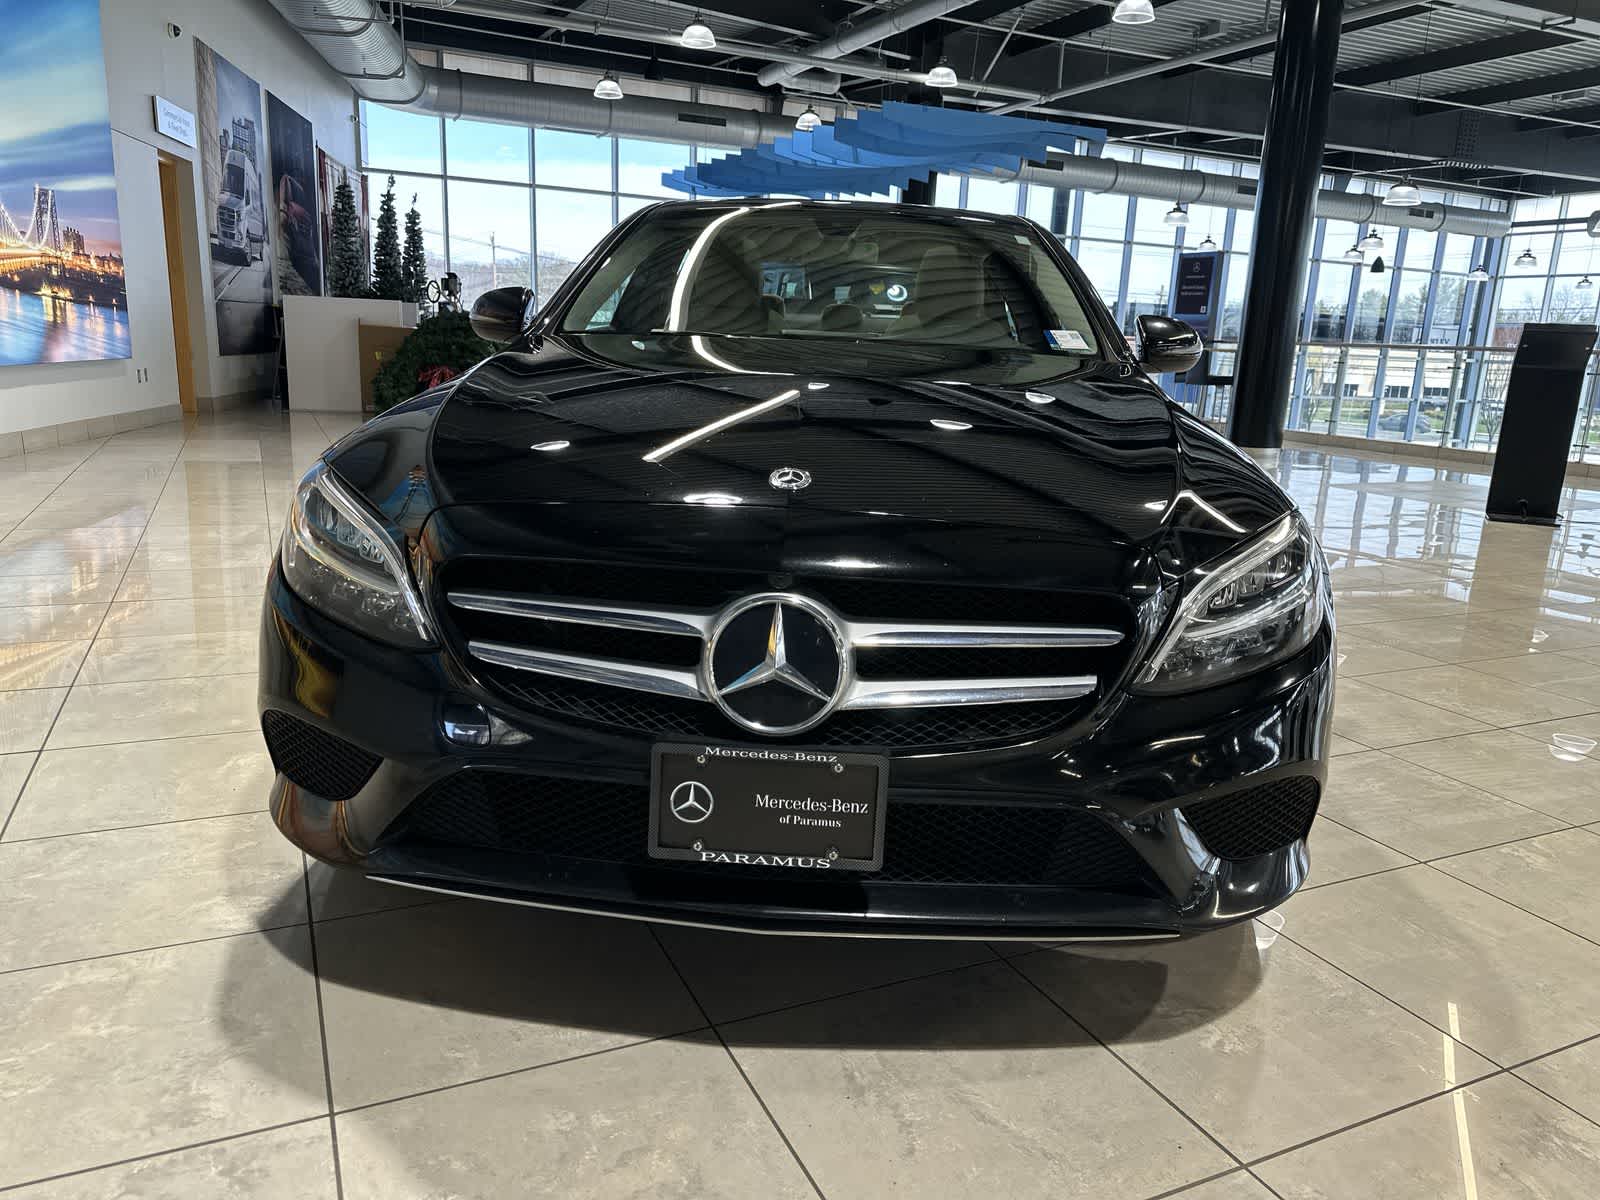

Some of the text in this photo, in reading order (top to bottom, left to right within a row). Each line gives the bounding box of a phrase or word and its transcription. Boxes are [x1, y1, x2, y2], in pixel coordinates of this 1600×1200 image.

[704, 746, 838, 763] Mercedes-Benz
[754, 793, 869, 814] Mercedes-Benz
[779, 814, 842, 828] of Paramus
[700, 851, 831, 869] PARAMUS
